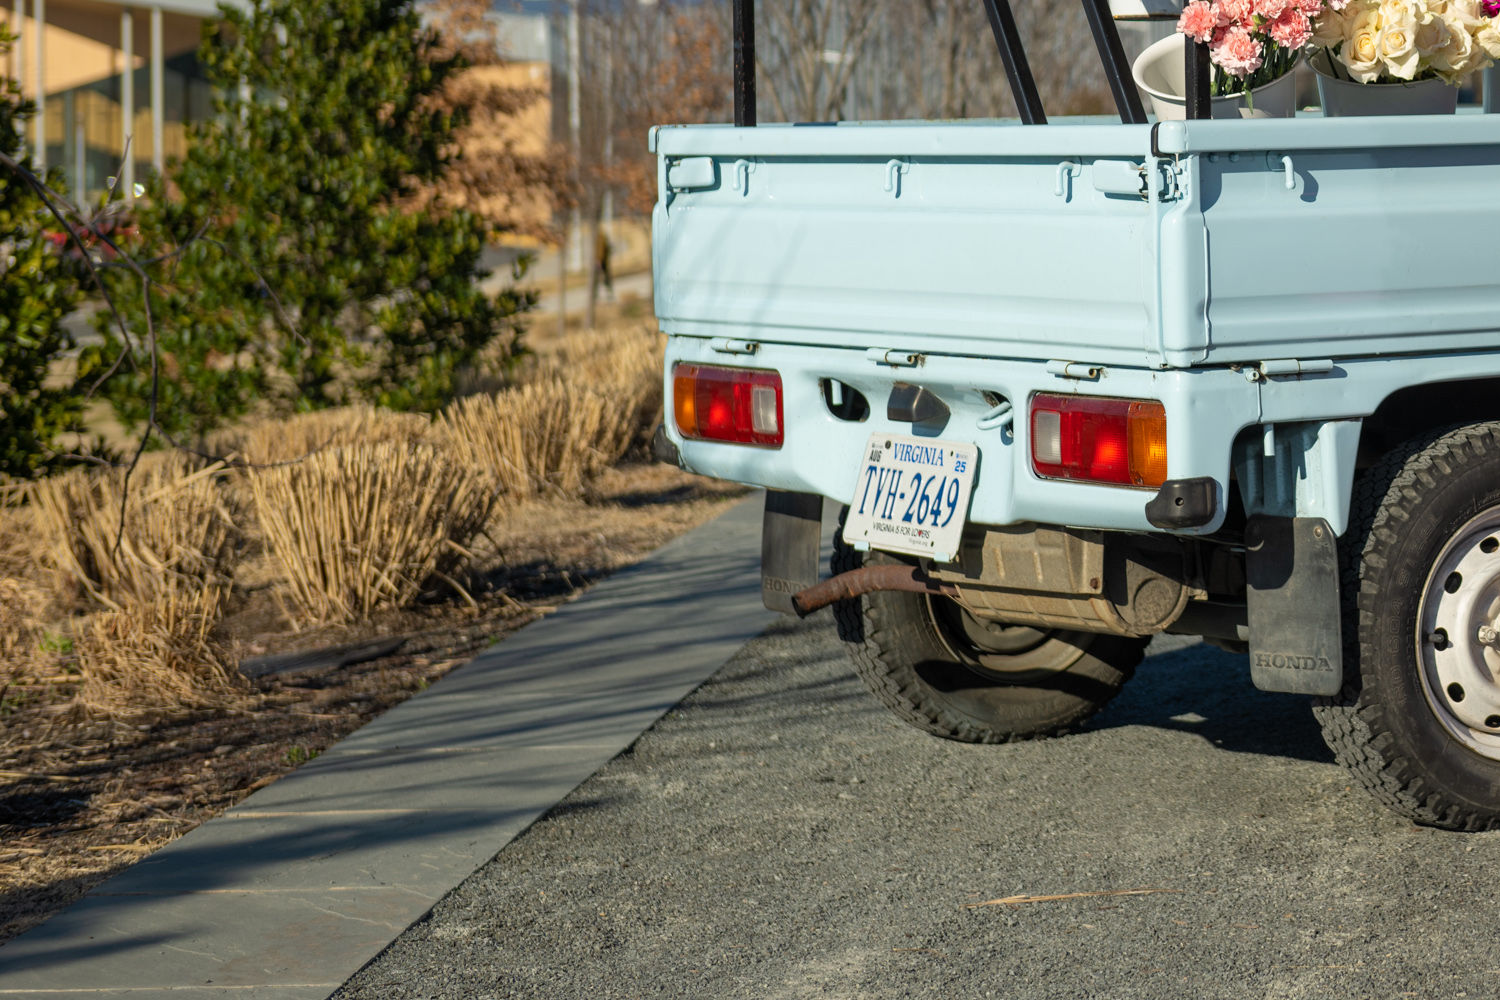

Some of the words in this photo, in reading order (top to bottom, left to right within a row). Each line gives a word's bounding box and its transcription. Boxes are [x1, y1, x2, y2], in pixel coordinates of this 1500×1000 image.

[869, 449, 882, 463] AUG
[893, 442, 944, 467] VIRGINIA
[954, 461, 967, 473] 25
[872, 521, 895, 534] VIRGINIA
[899, 526, 911, 536] FOR
[1255, 652, 1334, 673] HONDA
